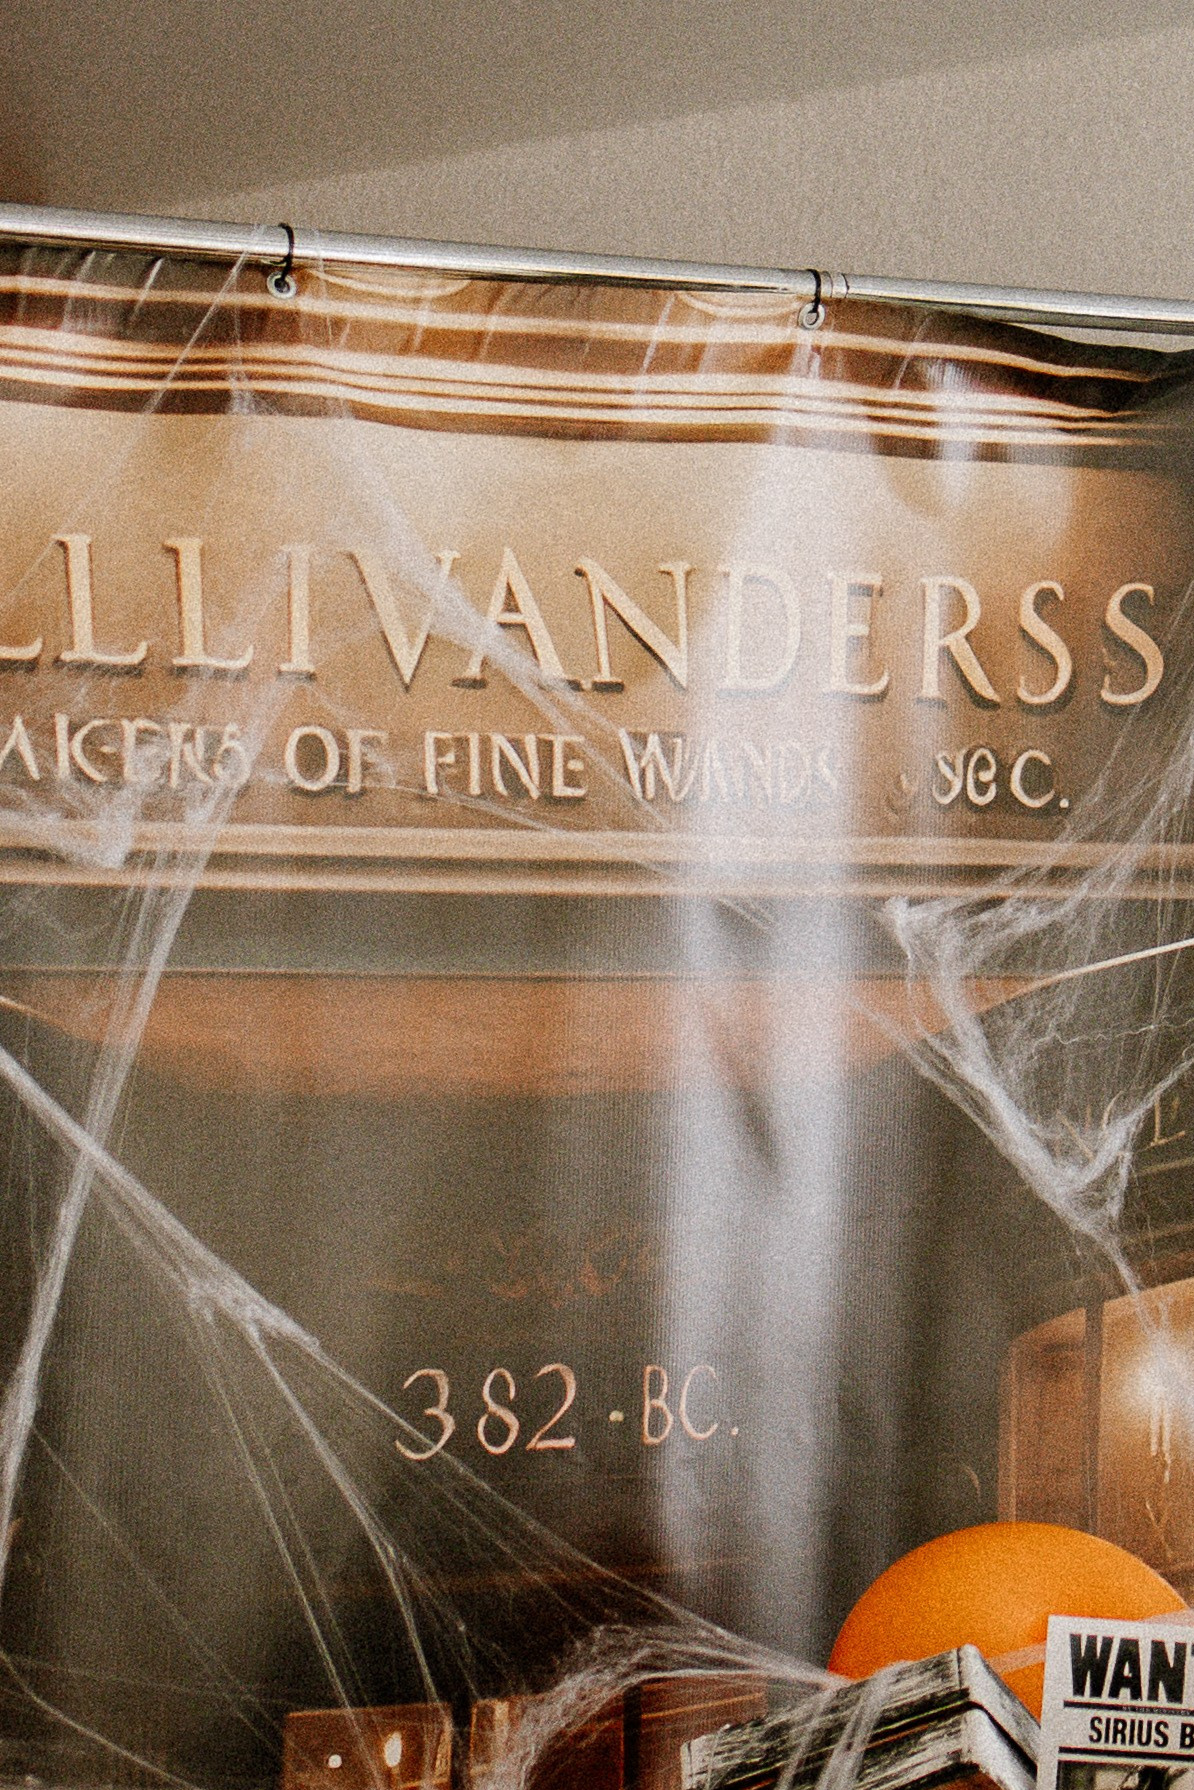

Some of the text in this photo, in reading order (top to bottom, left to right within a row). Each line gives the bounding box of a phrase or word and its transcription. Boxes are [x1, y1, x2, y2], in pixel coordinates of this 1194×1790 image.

[285, 725, 389, 793] OF
[424, 730, 587, 799] FINE
[395, 1363, 577, 1461] 382
[1088, 1716, 1170, 1748] SIRIUS
